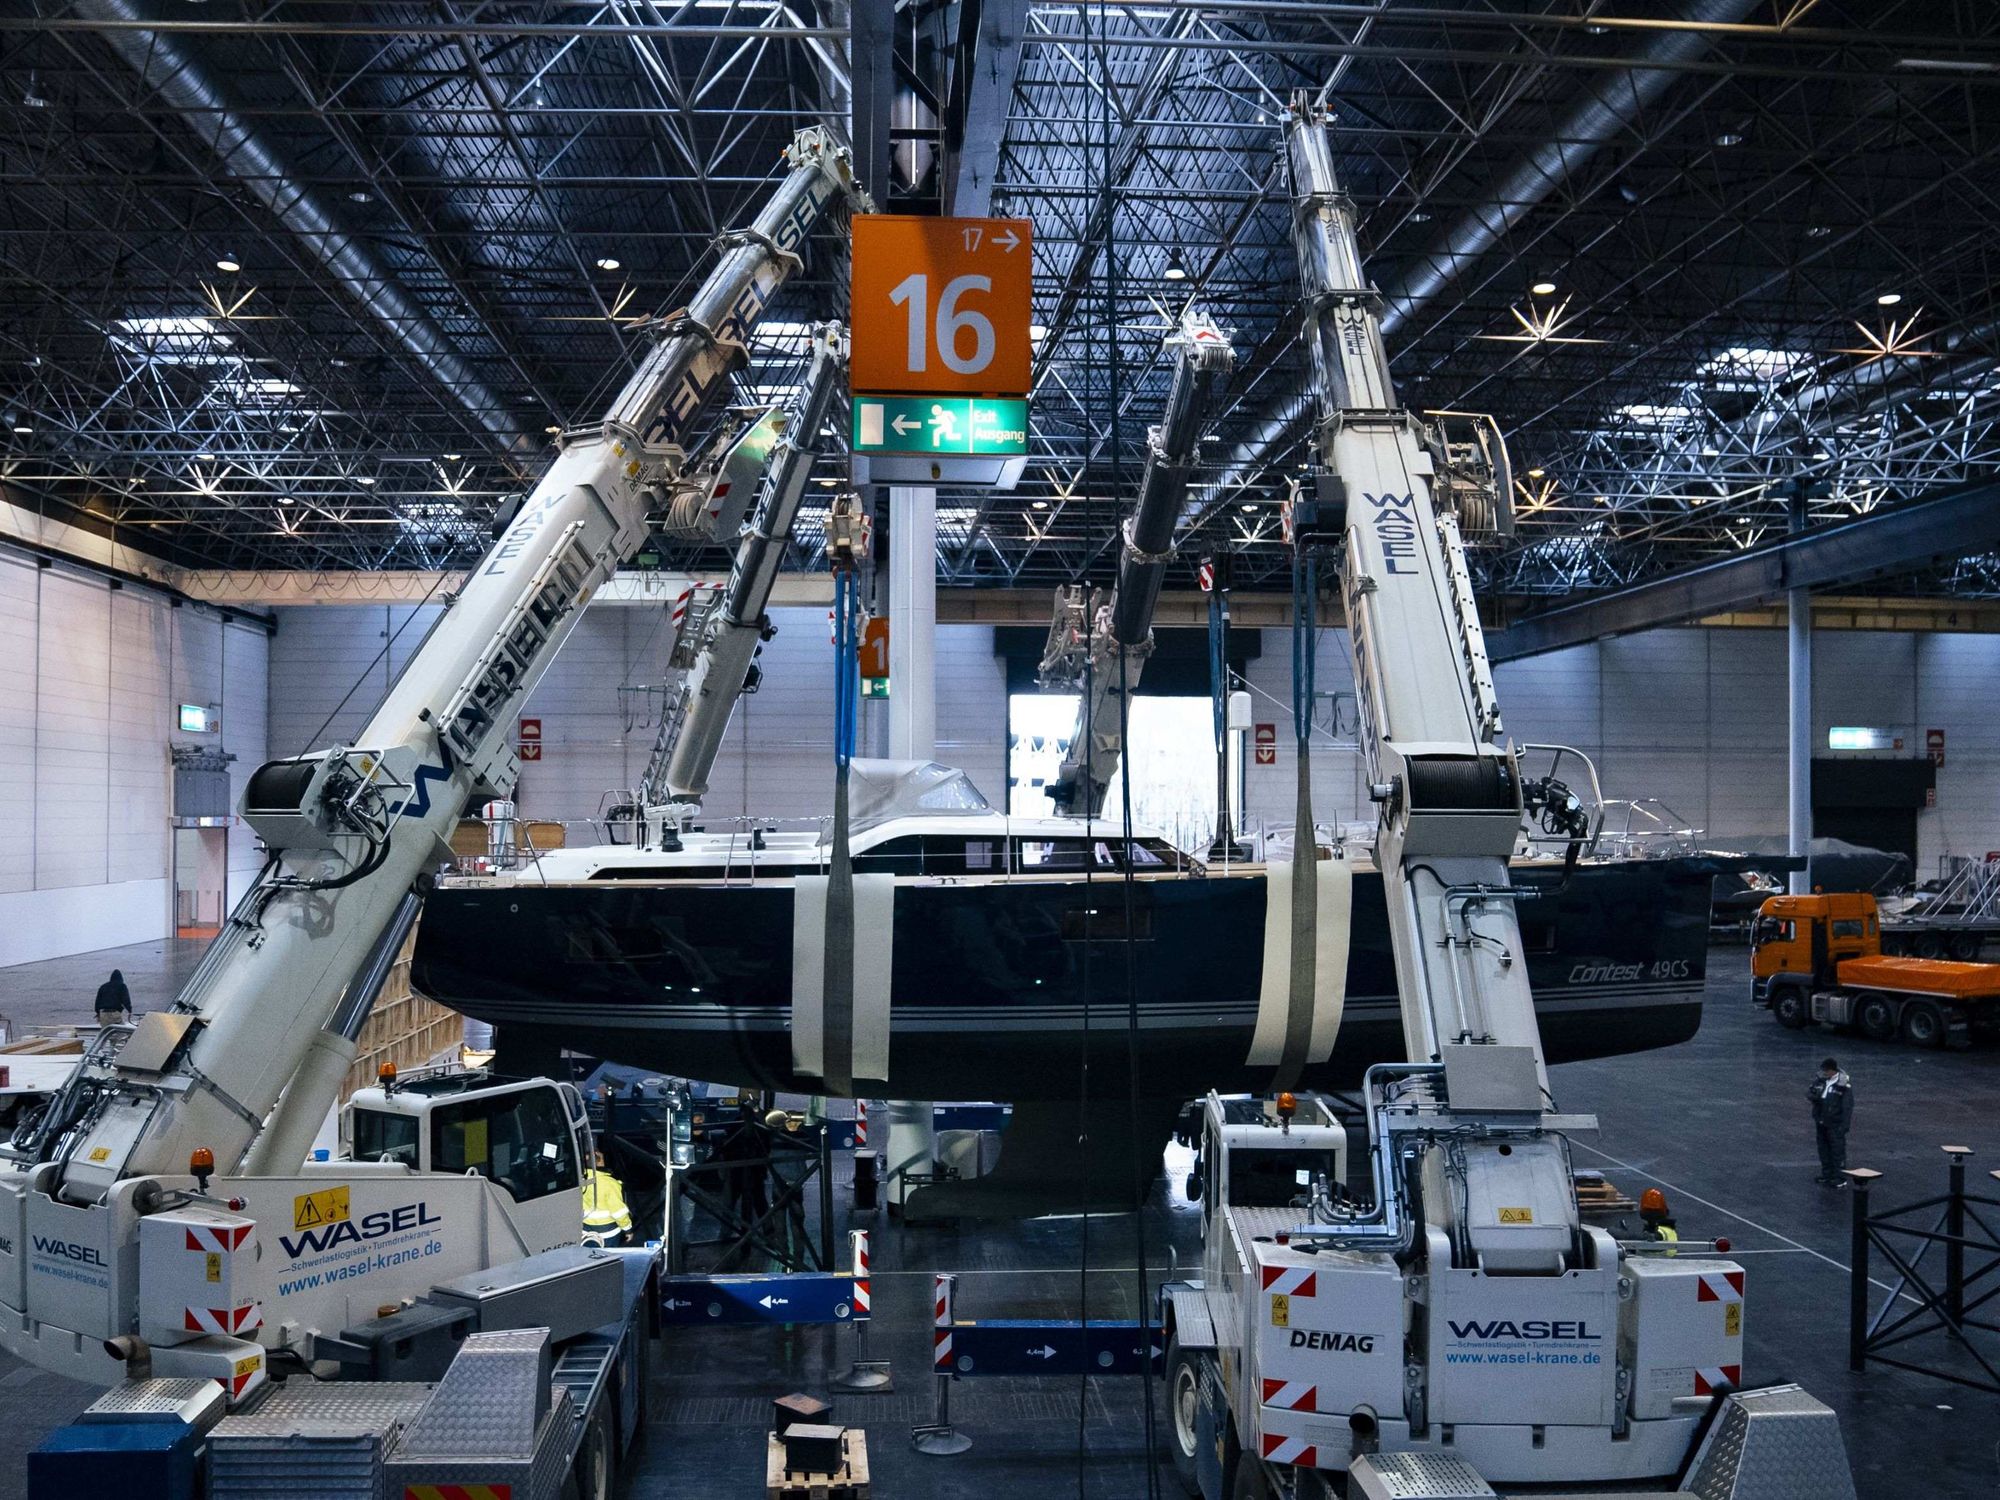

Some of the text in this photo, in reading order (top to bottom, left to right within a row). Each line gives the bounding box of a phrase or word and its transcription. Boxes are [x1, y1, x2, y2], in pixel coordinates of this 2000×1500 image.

[962, 228, 983, 251] 17
[889, 274, 995, 374] 16
[975, 429, 1025, 443] Ausgang
[484, 494, 566, 576] WASEL
[1362, 492, 1419, 576] WASEL
[1569, 960, 1689, 983] Contest 49CS
[279, 1202, 441, 1258] WASEL
[32, 1235, 108, 1267] WASEL
[291, 1229, 431, 1272] Schwerlastlogistik Turmdrehkrane
[279, 1240, 442, 1296] www.wasel-krane.de
[1290, 1330, 1374, 1353] DEMAG
[1447, 1321, 1601, 1339] WASEL
[1446, 1352, 1601, 1364] www.wasel-krane.de
[1457, 1341, 1527, 1350] Schwerlastlogistik
